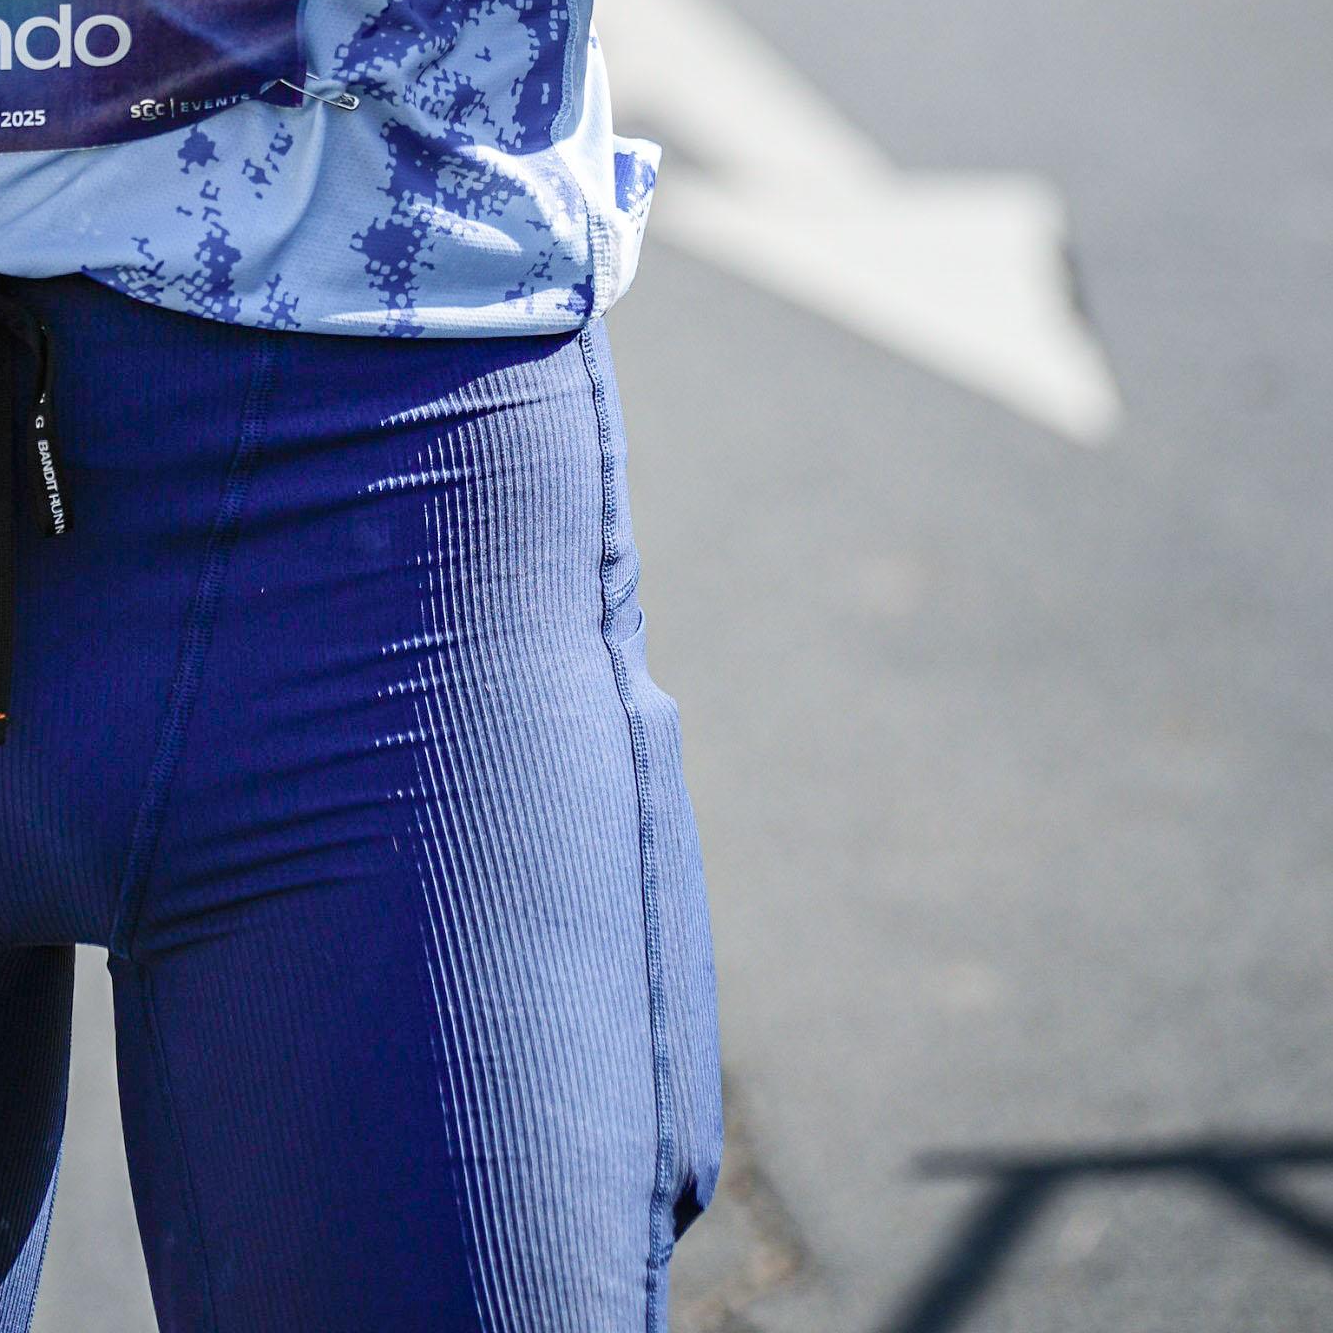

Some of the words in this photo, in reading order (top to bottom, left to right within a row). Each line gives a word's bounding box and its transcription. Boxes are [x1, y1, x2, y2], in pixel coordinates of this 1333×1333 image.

[0, 109, 46, 128] 2025
[130, 100, 166, 120] SCC
[38, 439, 58, 492] BANDIT
